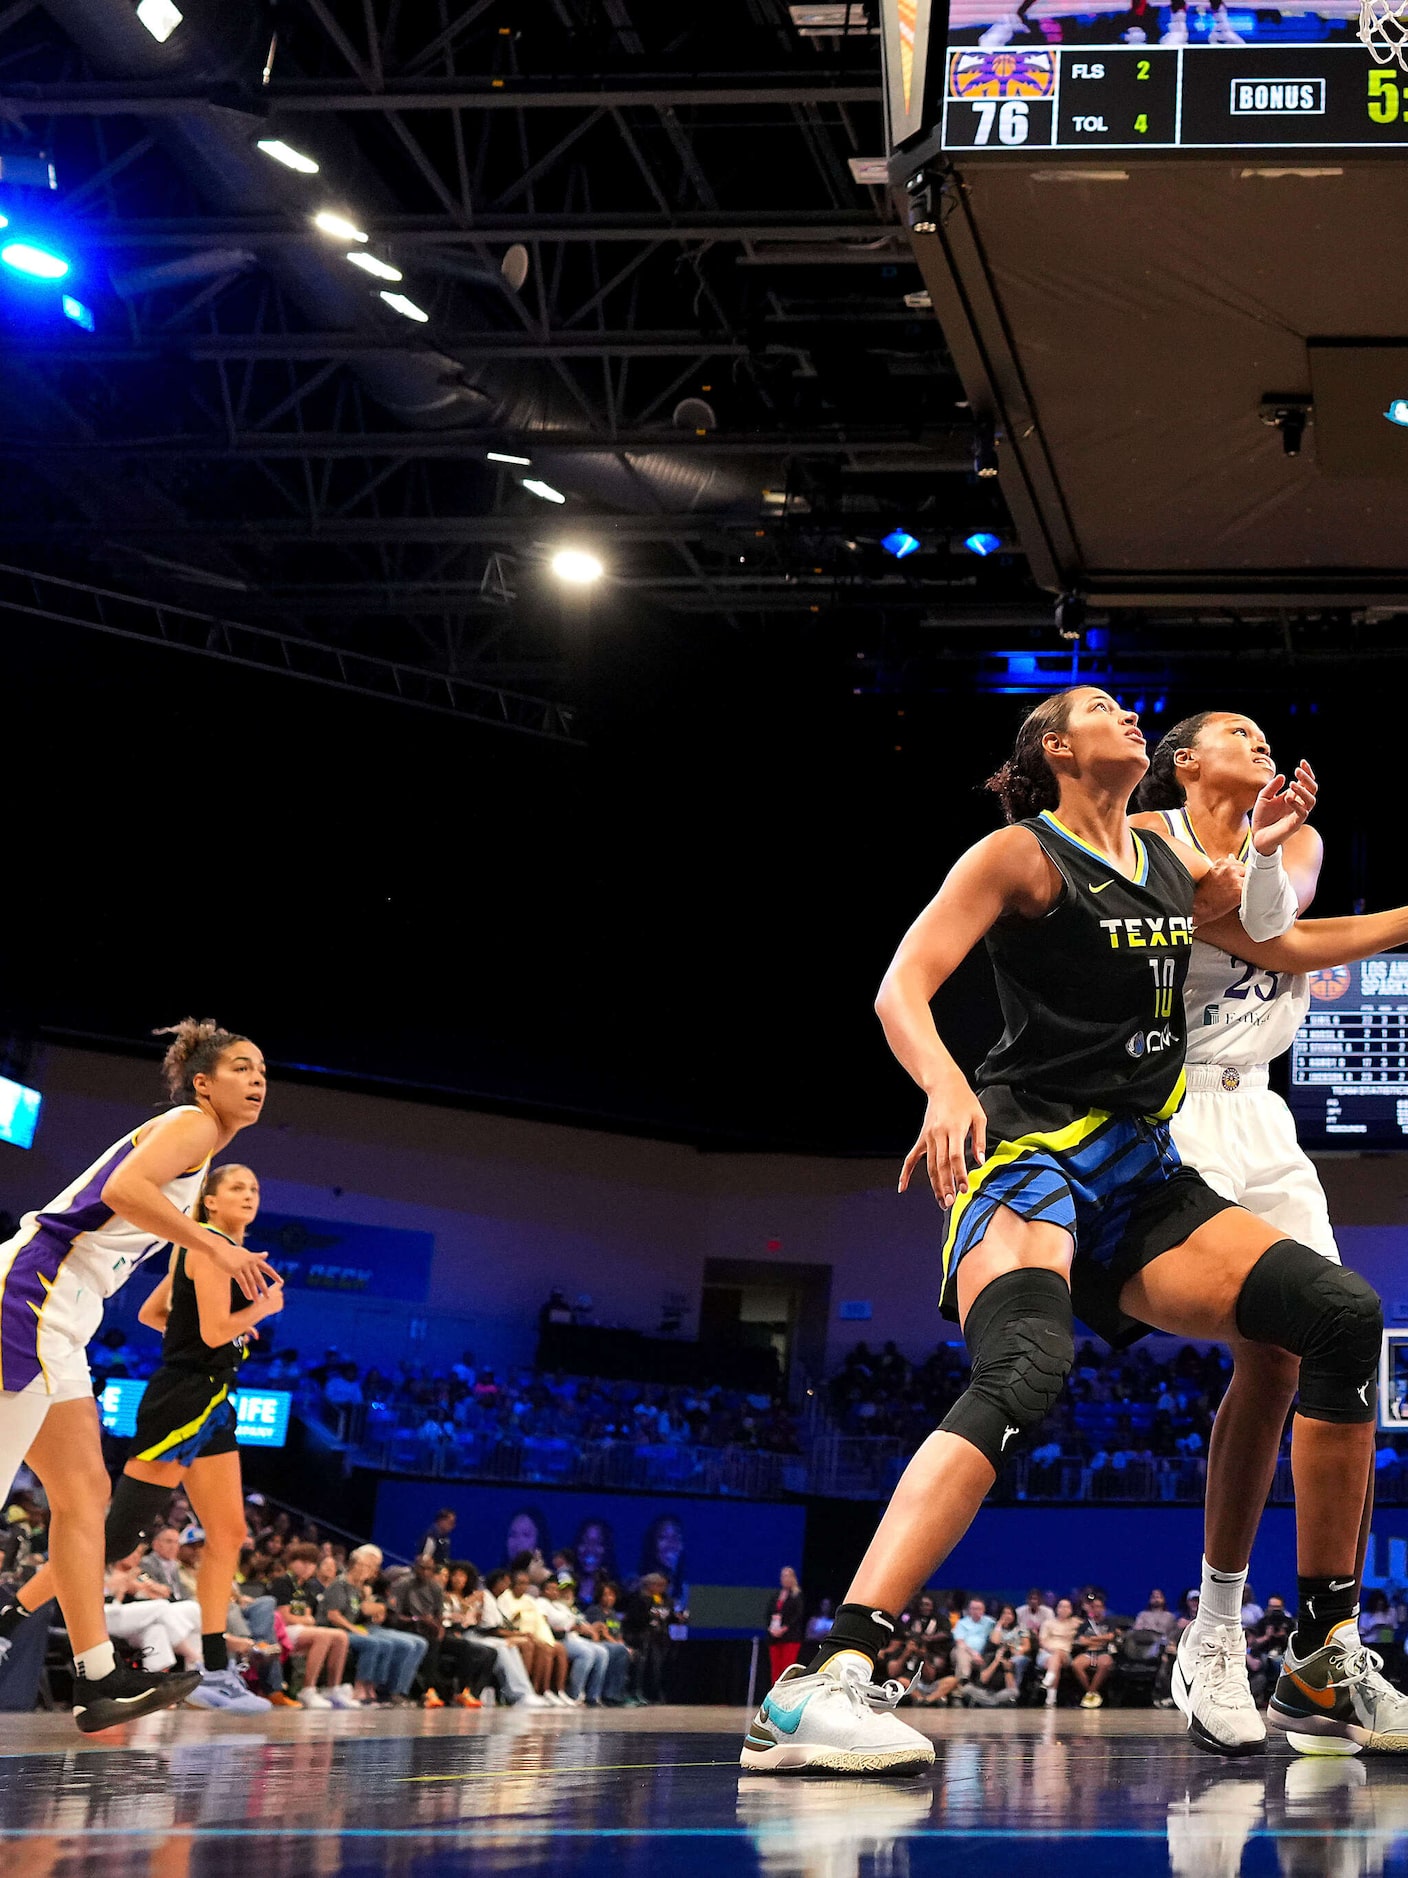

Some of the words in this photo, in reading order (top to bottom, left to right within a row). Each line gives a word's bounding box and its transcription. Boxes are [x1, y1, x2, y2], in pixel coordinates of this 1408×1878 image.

[1072, 63, 1105, 80] FLS
[1136, 61, 1151, 80] 2
[1238, 83, 1314, 111] BONUS
[971, 101, 1030, 146] 76
[1072, 116, 1109, 133] TOL
[1133, 114, 1149, 135] 4
[1360, 961, 1388, 979] LOS
[1148, 957, 1176, 1019] 10
